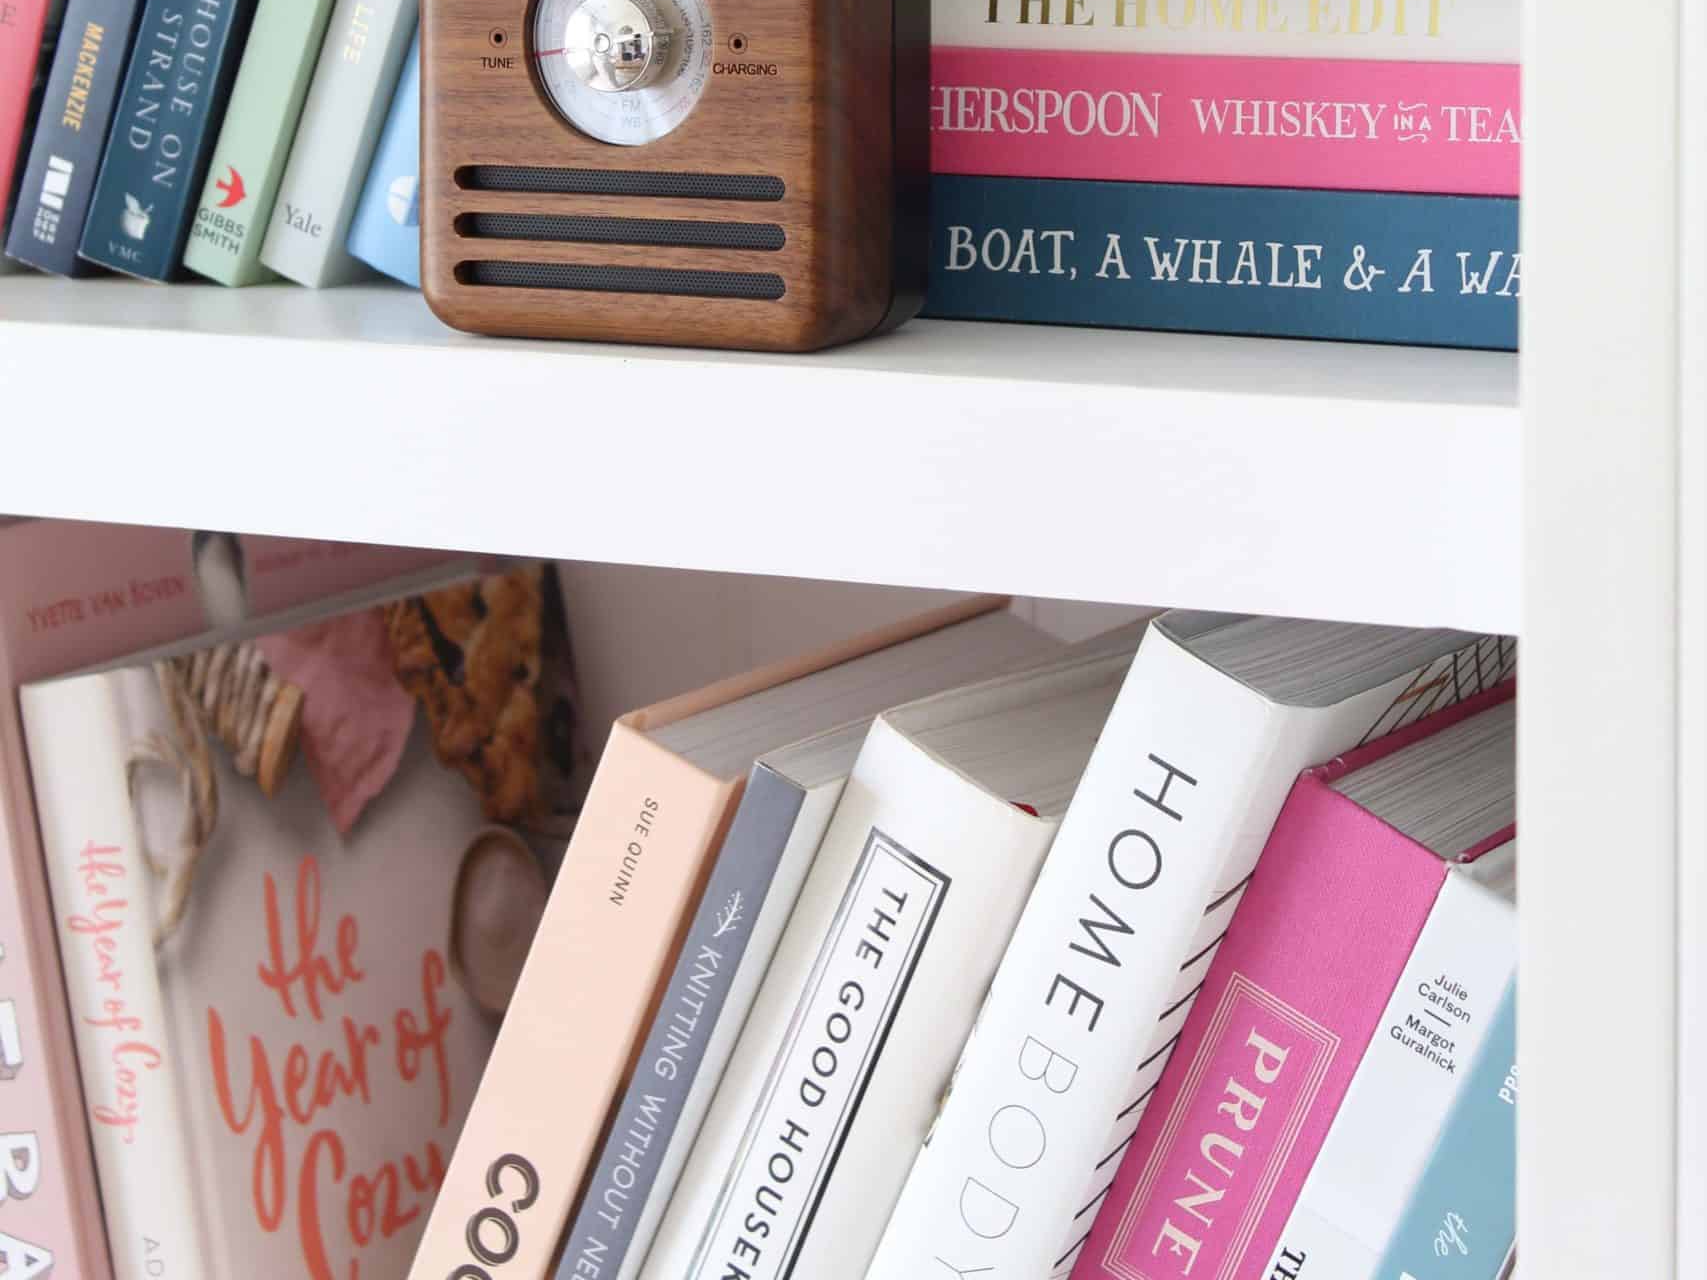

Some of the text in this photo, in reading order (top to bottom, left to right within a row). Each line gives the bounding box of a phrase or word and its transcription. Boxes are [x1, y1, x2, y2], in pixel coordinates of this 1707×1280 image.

[63, 21, 104, 132] MACKENZIE
[128, 8, 183, 152] STRAND
[480, 56, 514, 70] TUNE
[712, 62, 778, 77] CHARGING
[930, 86, 1163, 138] HERSPOON
[1191, 98, 1388, 140] WHISKEY
[1393, 113, 1414, 131] IN
[1417, 115, 1432, 131] A
[151, 132, 183, 190] ON
[192, 223, 241, 255] SMITH
[198, 206, 245, 238] GIBBS
[282, 202, 323, 238] Yale
[944, 225, 1077, 281] BOAT,
[1095, 233, 1131, 279] A
[1143, 236, 1323, 289] WHALE
[1343, 245, 1386, 293] &
[1397, 249, 1434, 293] A
[80, 839, 127, 897] the
[608, 796, 660, 907] SUE QUINN
[258, 855, 366, 1021] the
[855, 885, 909, 969] THE
[1417, 982, 1472, 1024] Carlson
[1434, 974, 1468, 1001] Julie
[84, 1000, 142, 1041] of
[394, 949, 452, 1128] of
[798, 980, 866, 1108] GOOD
[1390, 1025, 1456, 1074] Guralnick
[1405, 1013, 1456, 1053] Margot
[94, 1041, 161, 1144] Cozy
[571, 945, 723, 1280] KNITTING WITHOUT NE
[1151, 1026, 1288, 1276] PRUNE
